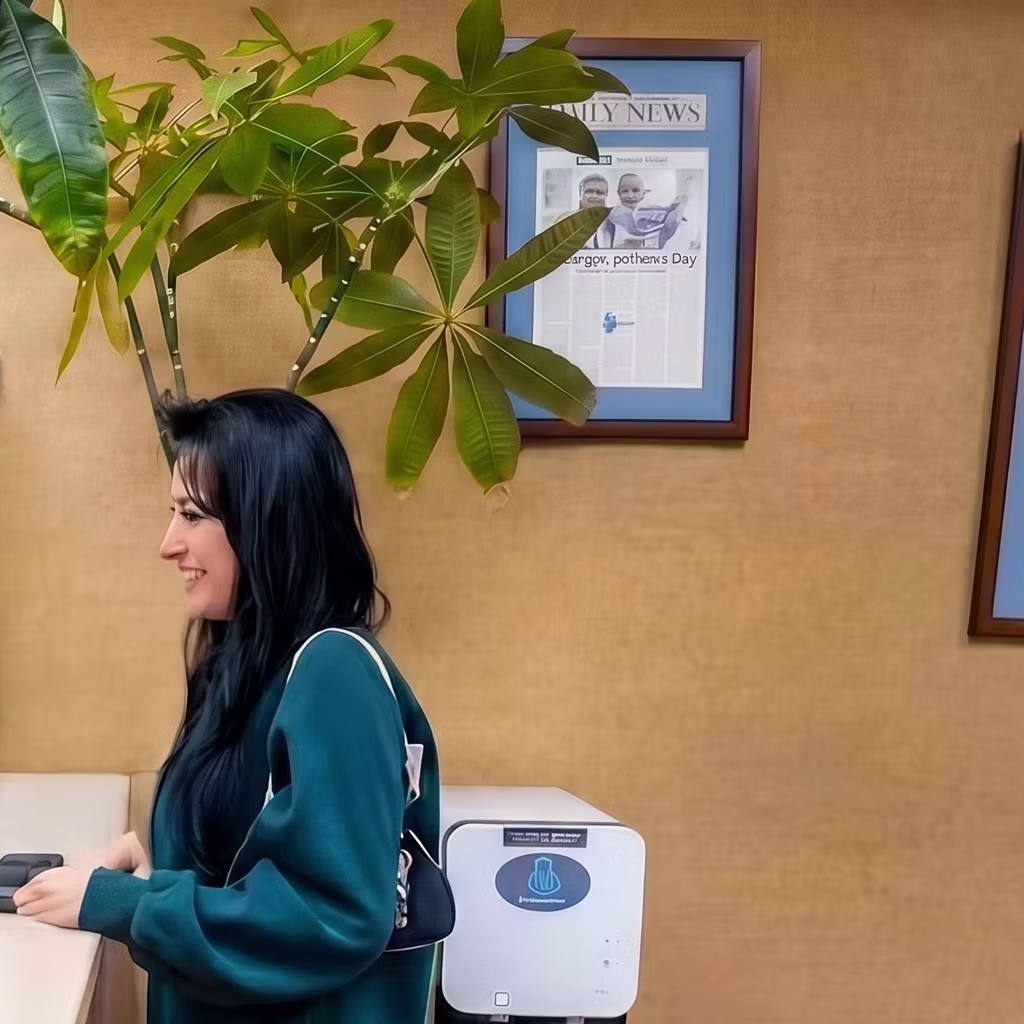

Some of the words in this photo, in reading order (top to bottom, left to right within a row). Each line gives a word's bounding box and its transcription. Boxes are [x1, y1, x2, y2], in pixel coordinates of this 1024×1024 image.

[549, 102, 618, 122] AILY
[626, 102, 700, 123] NEWS
[672, 252, 697, 269] Day
